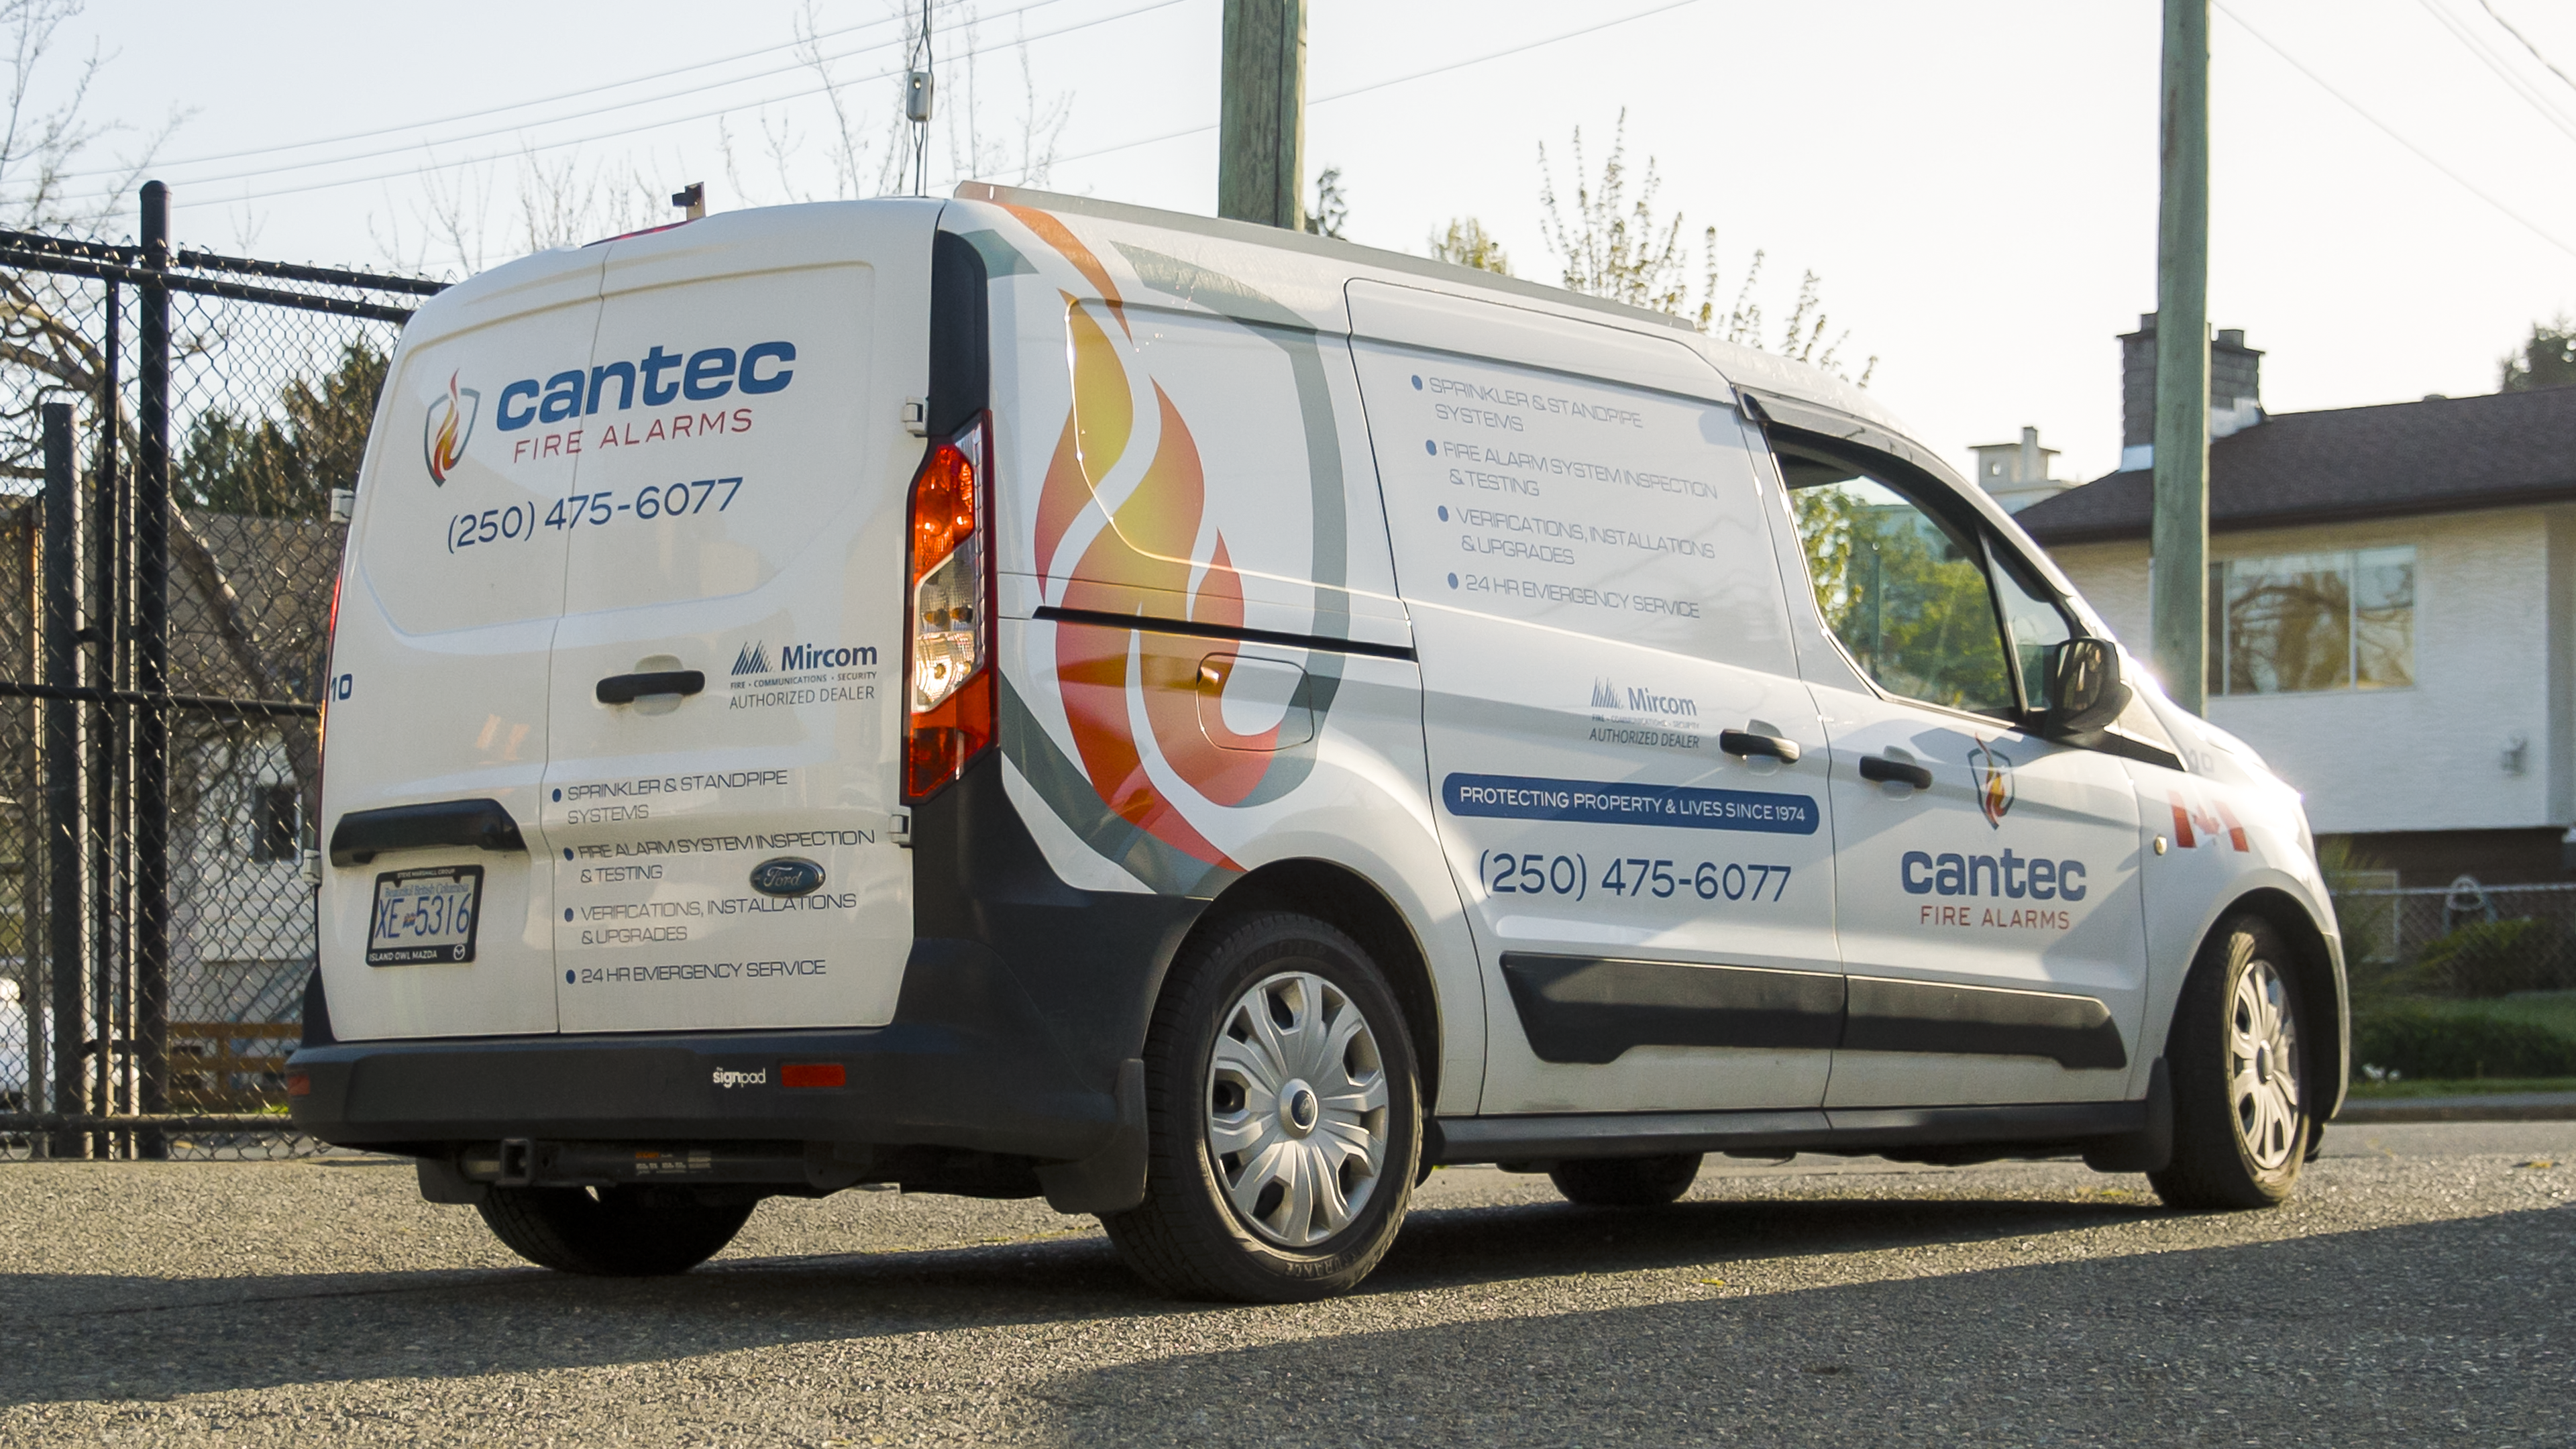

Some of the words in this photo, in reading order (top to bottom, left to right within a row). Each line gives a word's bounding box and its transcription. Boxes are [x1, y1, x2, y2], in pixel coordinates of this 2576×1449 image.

[496, 341, 796, 431] cantec
[1429, 377, 1529, 409] SPRINKLER
[1533, 395, 1546, 410] &
[1548, 398, 1643, 428] STANDPIPE
[1436, 404, 1523, 431] SYSTEMS
[514, 430, 584, 463] FIRE
[600, 409, 752, 449] ALARMS
[1443, 441, 1481, 462] FIRE
[1485, 447, 1548, 472] ALARM
[1551, 458, 1620, 483] SYSTEM
[1624, 470, 1717, 499] INSPECTION
[1450, 469, 1464, 485] &
[1466, 470, 1539, 496] TESTING
[448, 501, 535, 553] (250)
[545, 476, 743, 530] 475-6077
[1456, 508, 1587, 543] VERIFICATIONS,
[1591, 527, 1715, 559] INSTALLATIONS
[1462, 535, 1477, 551] &
[1478, 537, 1574, 565] UPGRADES
[1466, 574, 1489, 591] 24
[1494, 578, 1519, 596] HR
[1523, 582, 1628, 610] EMERGENCY
[1633, 595, 1700, 619] SERVICE
[782, 643, 877, 672] Mircom
[331, 674, 352, 702] 10
[731, 681, 745, 690] FIRE
[754, 674, 826, 688] COMMUNICATIONS
[838, 672, 877, 681] SECURITY
[729, 690, 815, 710] AUTHORIZED
[820, 686, 875, 702] DEALER
[1627, 687, 1697, 716] Mircom
[1589, 727, 1658, 746] AUTHORIZED
[1661, 732, 1699, 749] DEALER
[568, 777, 661, 801] SPRINKLER
[665, 777, 677, 792] &
[681, 770, 788, 790] STANDPIPE
[568, 804, 649, 824] SYSTEMS
[1460, 786, 1569, 808] PROTECTING
[1574, 794, 1662, 814] PROPERTY
[1666, 799, 1676, 814] &
[1680, 800, 1722, 817] LIVES
[1726, 804, 1772, 820] SINCE
[1775, 806, 1805, 821] 1974
[578, 845, 614, 860] FIRE
[616, 841, 675, 857] ALARM
[678, 837, 755, 853] SYSTEM
[757, 830, 874, 849] INSPECTION
[581, 869, 592, 883] &
[595, 865, 662, 881] TESTING
[762, 867, 802, 888] Ford
[1480, 849, 1587, 902] (250)
[1602, 858, 1791, 902] 475-6077
[1902, 848, 2086, 901] cantec
[374, 898, 405, 938] XE
[415, 893, 472, 936] 5316
[581, 902, 704, 921] VERIFICATIONS,
[708, 894, 856, 914] INSTALLATIONS
[1921, 906, 1971, 926] FIRE
[1982, 908, 2070, 930] ALARMS
[582, 930, 594, 945] &
[596, 926, 688, 943] UPGRADES
[370, 951, 392, 961] ISLAND
[394, 951, 411, 960] OWL
[412, 950, 437, 959] MAZDA
[582, 969, 606, 983] 24
[607, 968, 631, 982] HR
[634, 964, 742, 981] EMERGENCY
[746, 959, 826, 978] SERVICE
[713, 1067, 766, 1088] signpad
